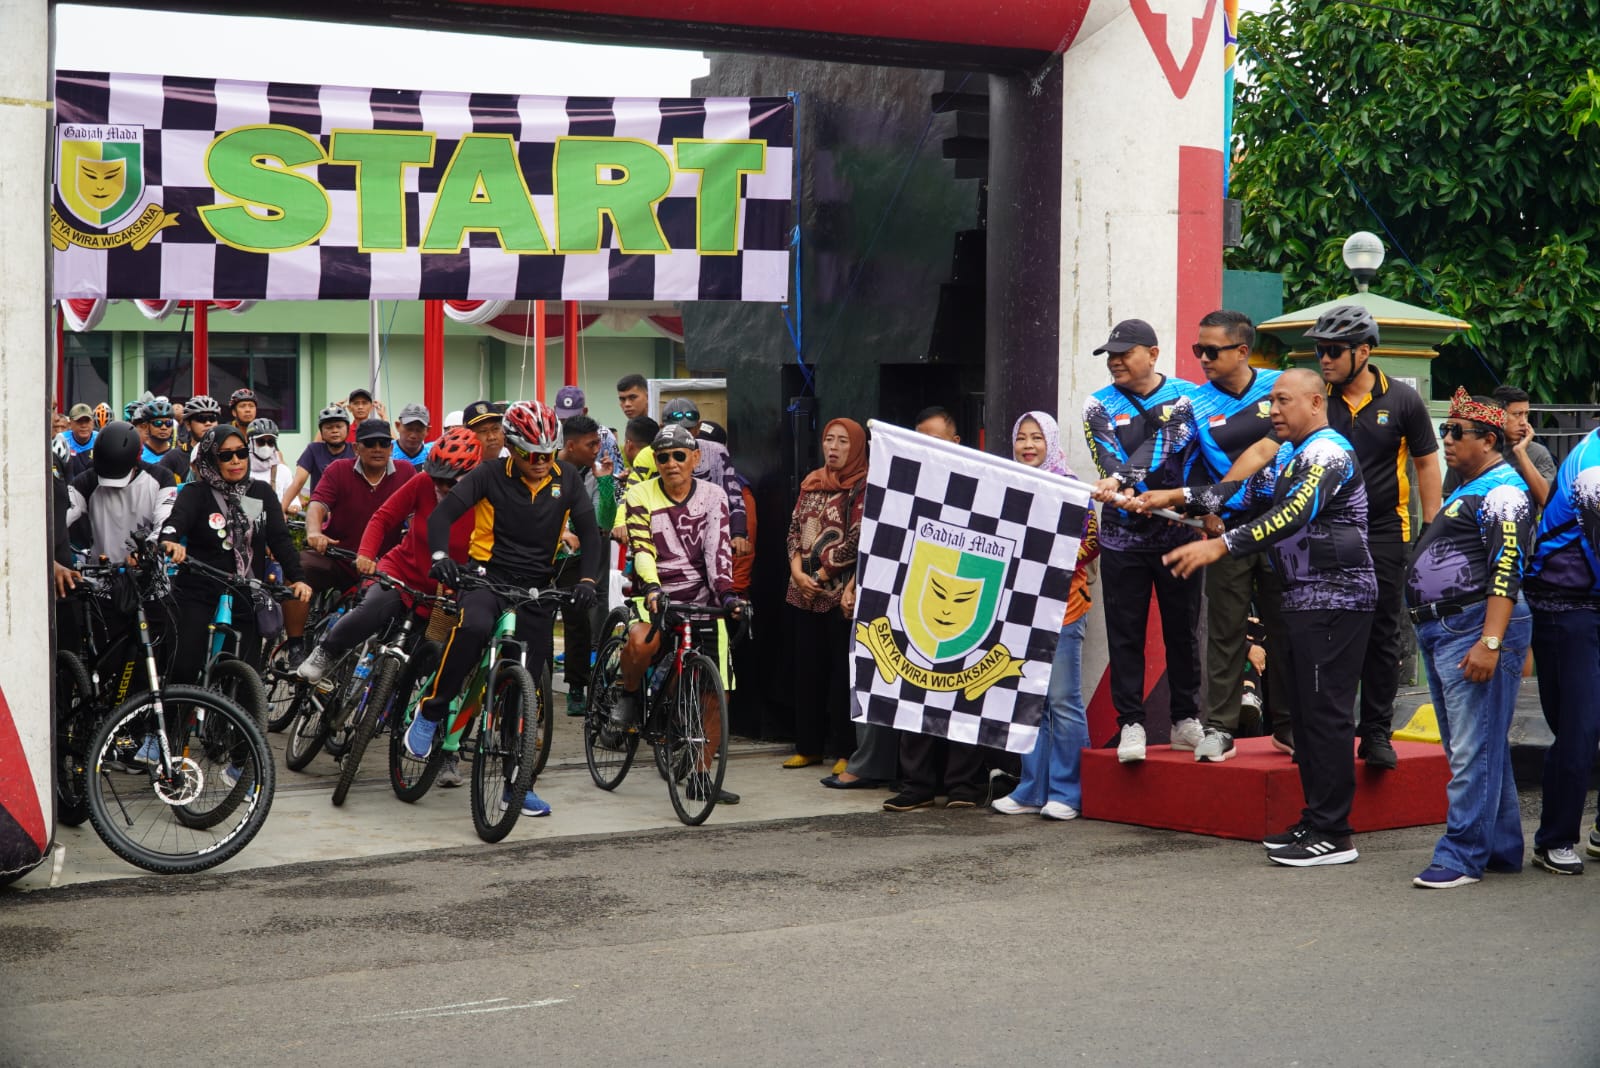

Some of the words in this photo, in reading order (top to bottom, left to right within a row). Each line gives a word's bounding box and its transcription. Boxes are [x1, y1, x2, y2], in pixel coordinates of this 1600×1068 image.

[64, 126, 103, 140] Gadjah
[105, 127, 137, 140] Mada
[197, 123, 767, 256] START
[51, 208, 71, 236] ATYA
[72, 230, 99, 247] WIRA
[101, 207, 158, 247] WICAKSANA
[920, 522, 966, 549] Gadjah
[968, 536, 1006, 558] Mada
[877, 622, 901, 666] SATYA
[901, 660, 928, 686] WIRA
[931, 650, 1004, 688] WICAKSANA
